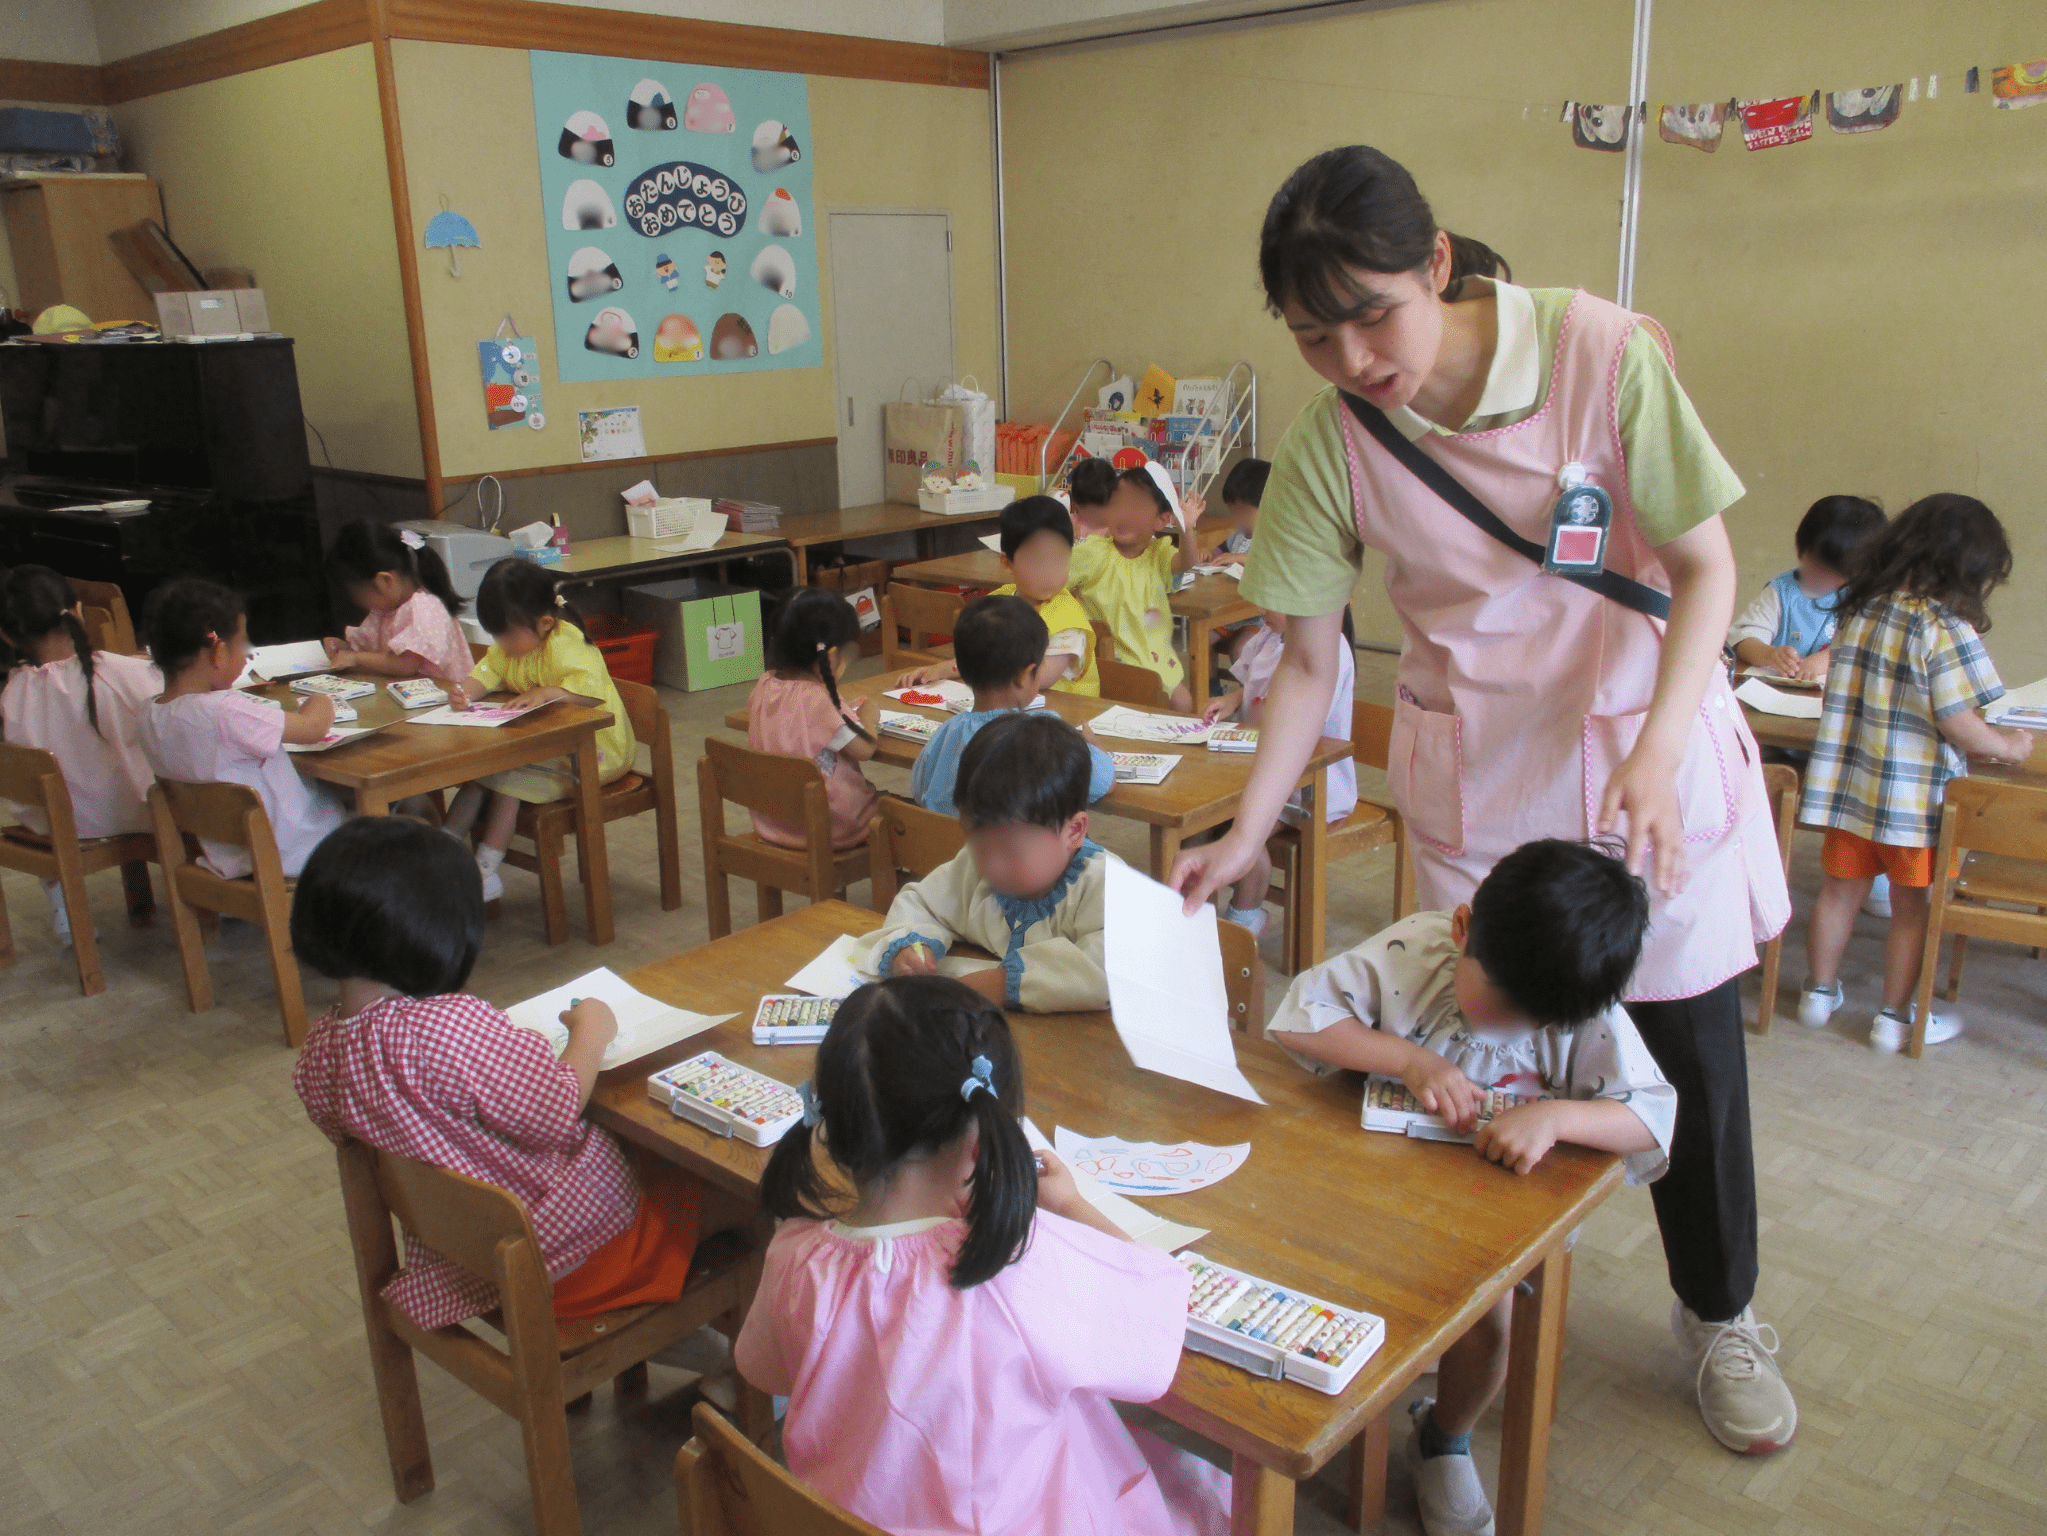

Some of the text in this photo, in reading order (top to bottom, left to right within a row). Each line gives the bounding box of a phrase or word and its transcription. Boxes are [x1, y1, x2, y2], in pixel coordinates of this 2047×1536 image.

[628, 168, 744, 217] おたんじょうび
[644, 203, 733, 234] おめでとう
[785, 289, 793, 299] 10
[630, 347, 636, 357] 2
